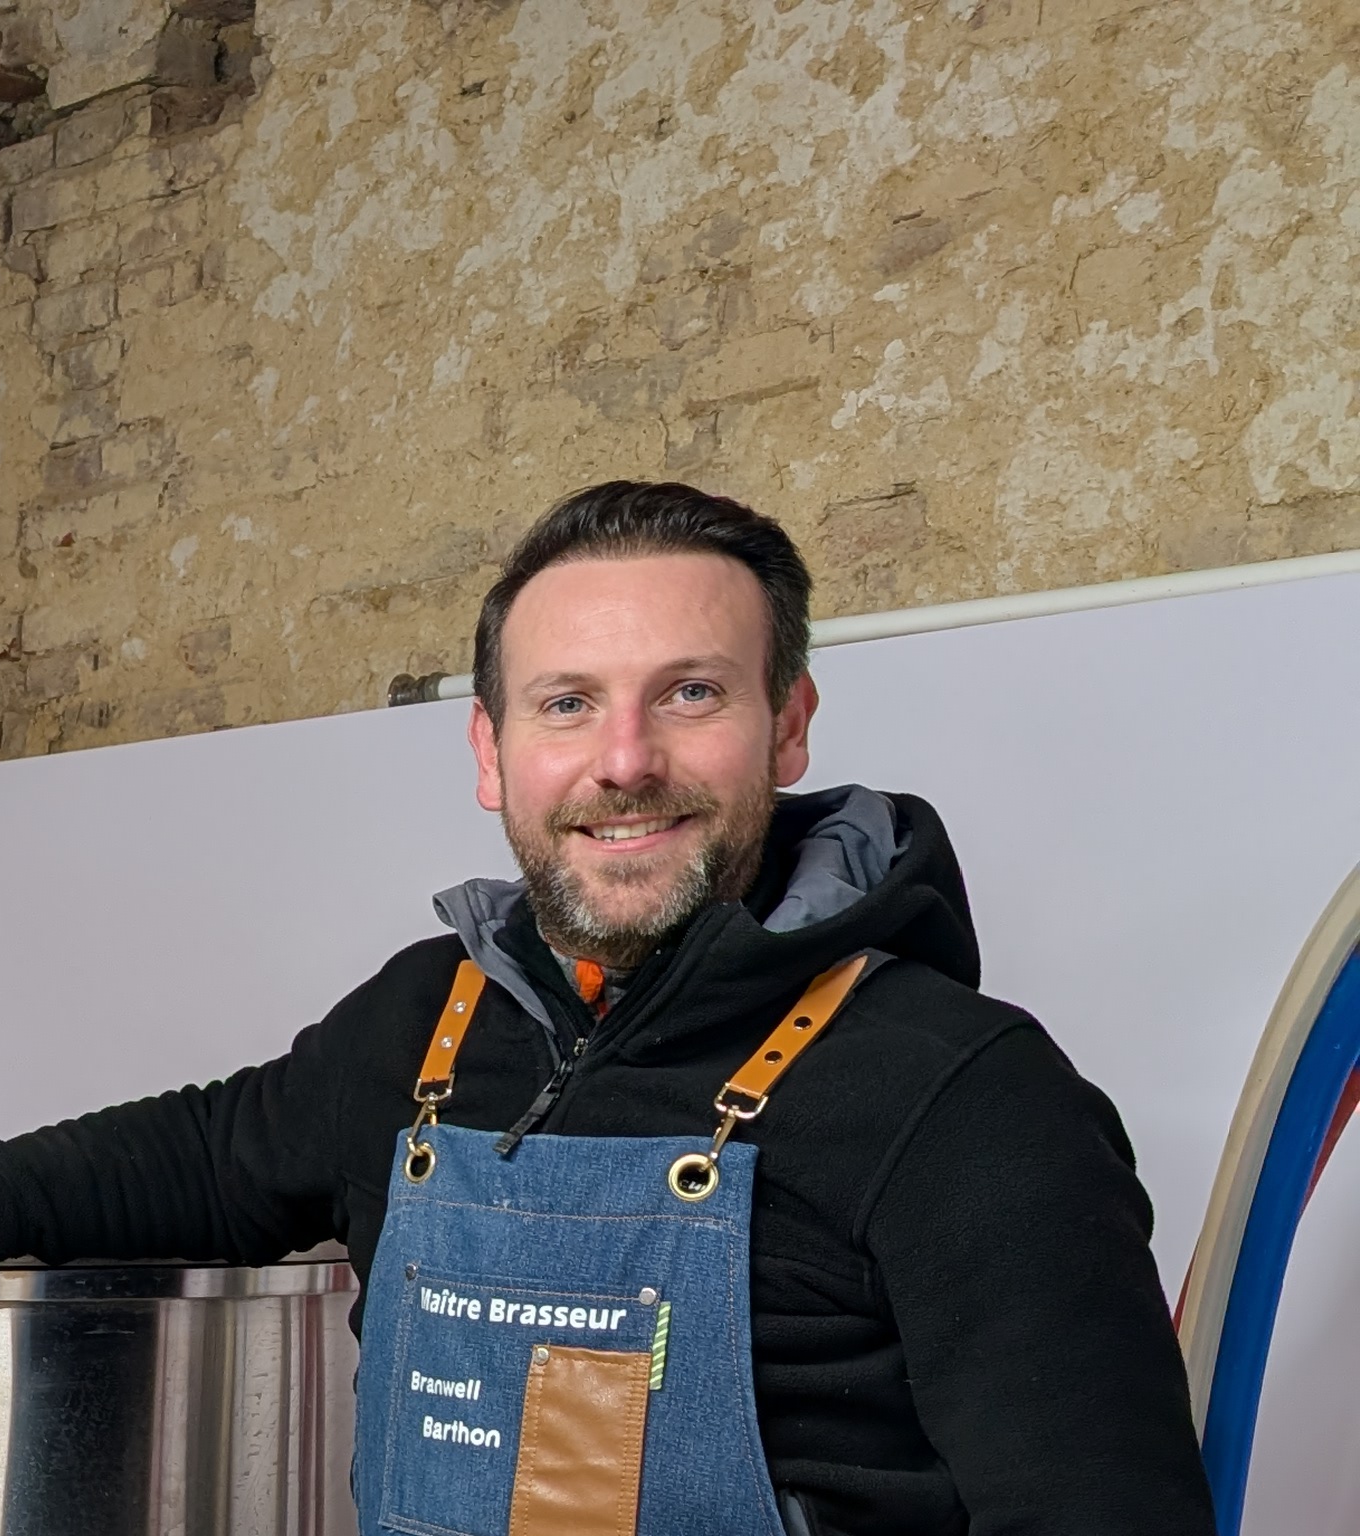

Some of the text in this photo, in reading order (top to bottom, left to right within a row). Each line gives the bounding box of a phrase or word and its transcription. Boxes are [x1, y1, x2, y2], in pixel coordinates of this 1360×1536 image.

[420, 1286, 626, 1331] Maître Brasseur
[410, 1371, 480, 1401] Branwell
[423, 1416, 501, 1448] Barthon
